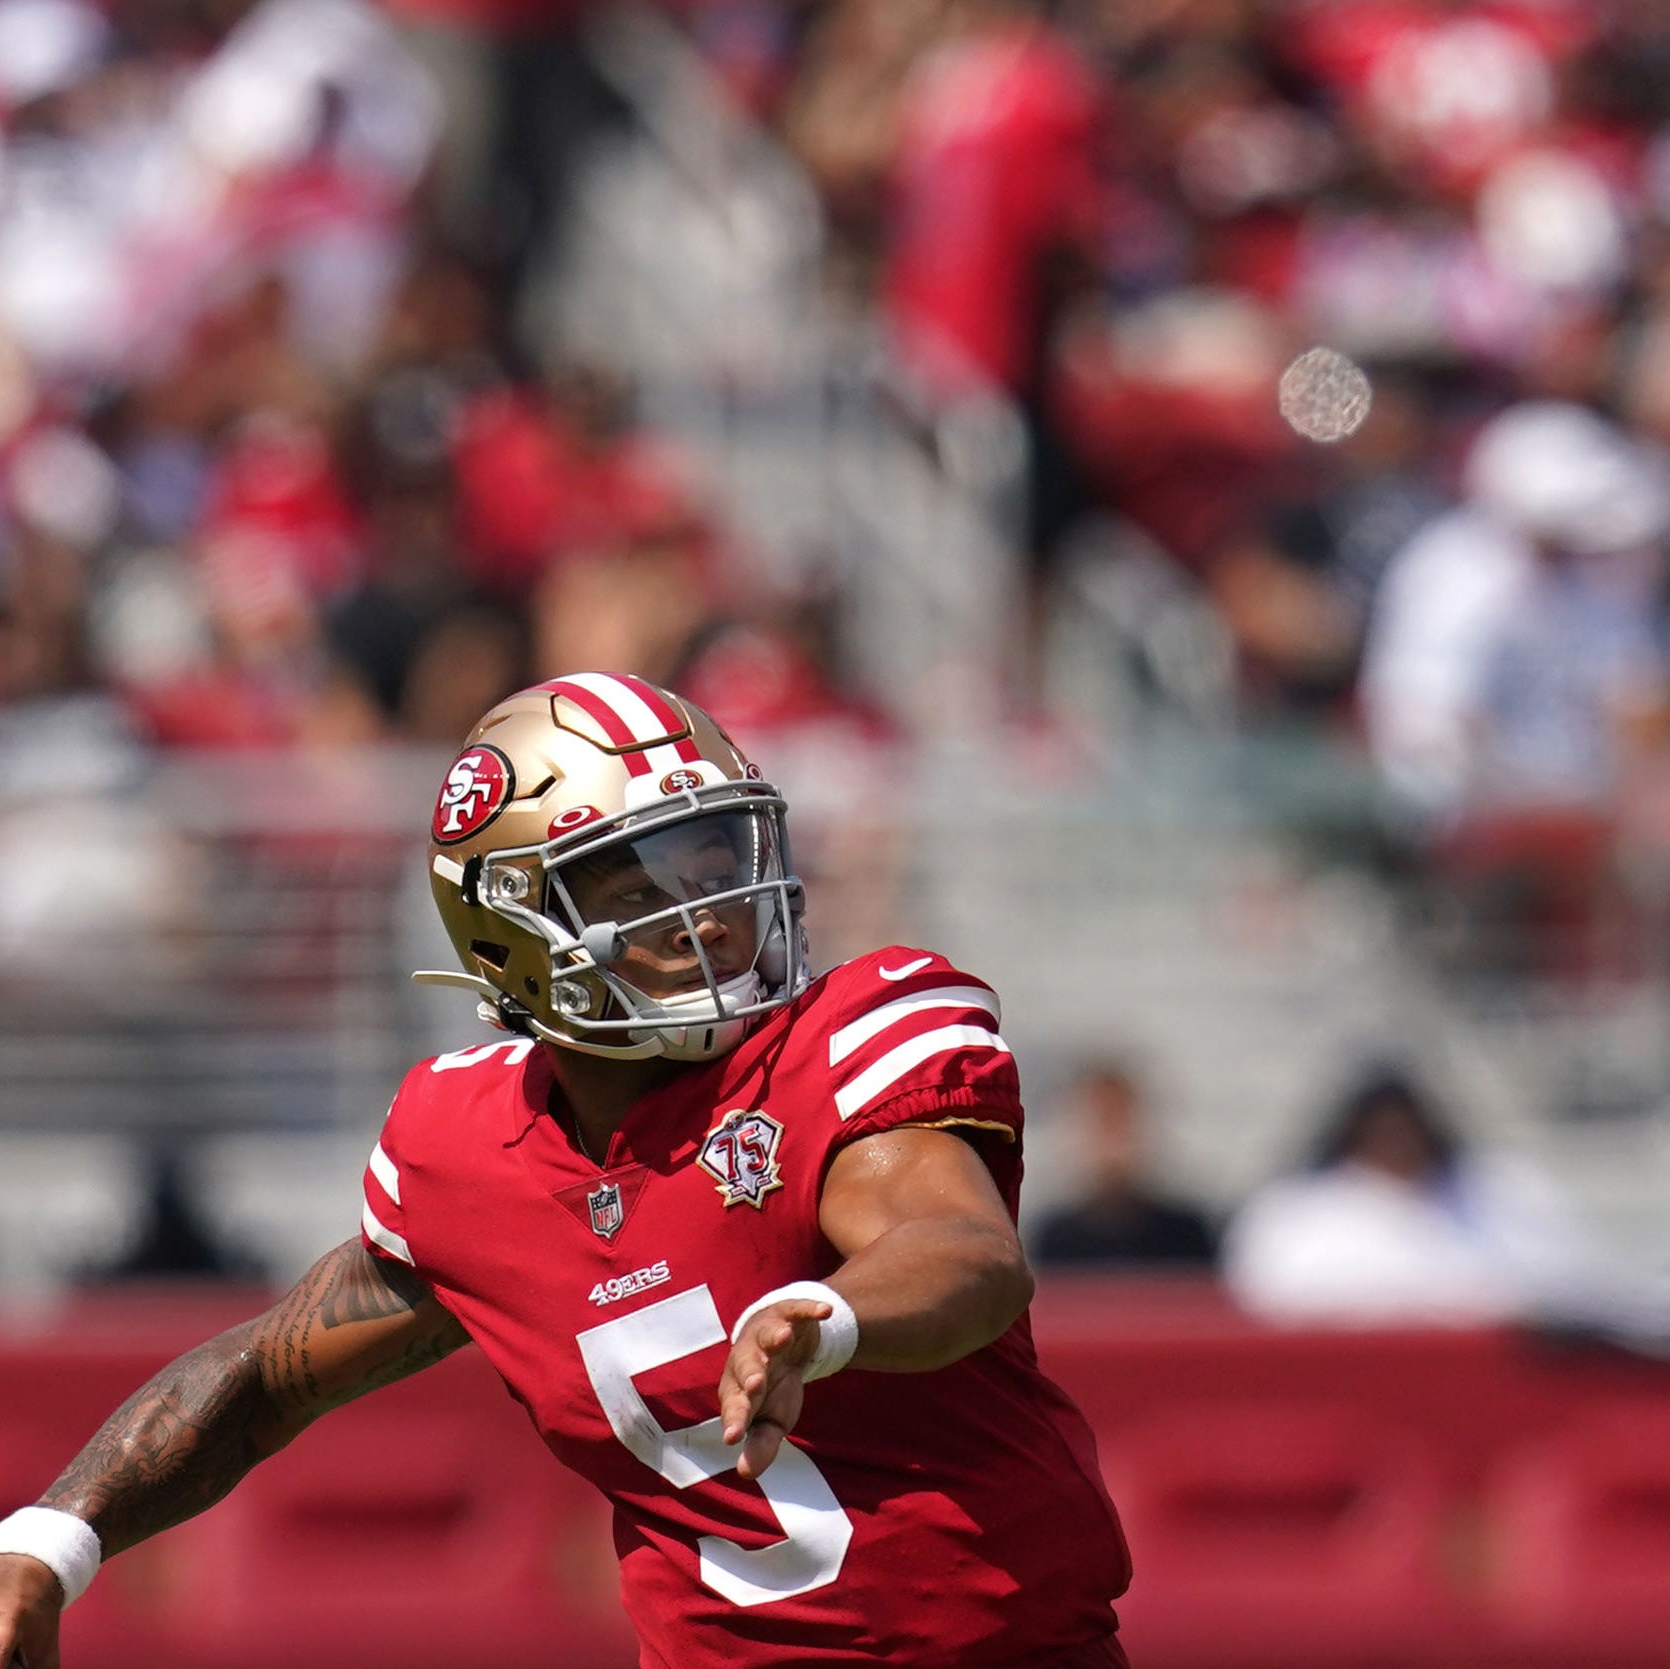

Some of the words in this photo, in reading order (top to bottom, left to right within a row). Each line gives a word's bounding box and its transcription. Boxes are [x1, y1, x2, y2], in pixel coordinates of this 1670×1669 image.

[440, 755, 492, 833] SF
[715, 1126, 768, 1183] 75
[587, 1259, 672, 1308] 49ERS
[575, 1283, 854, 1608] 5
